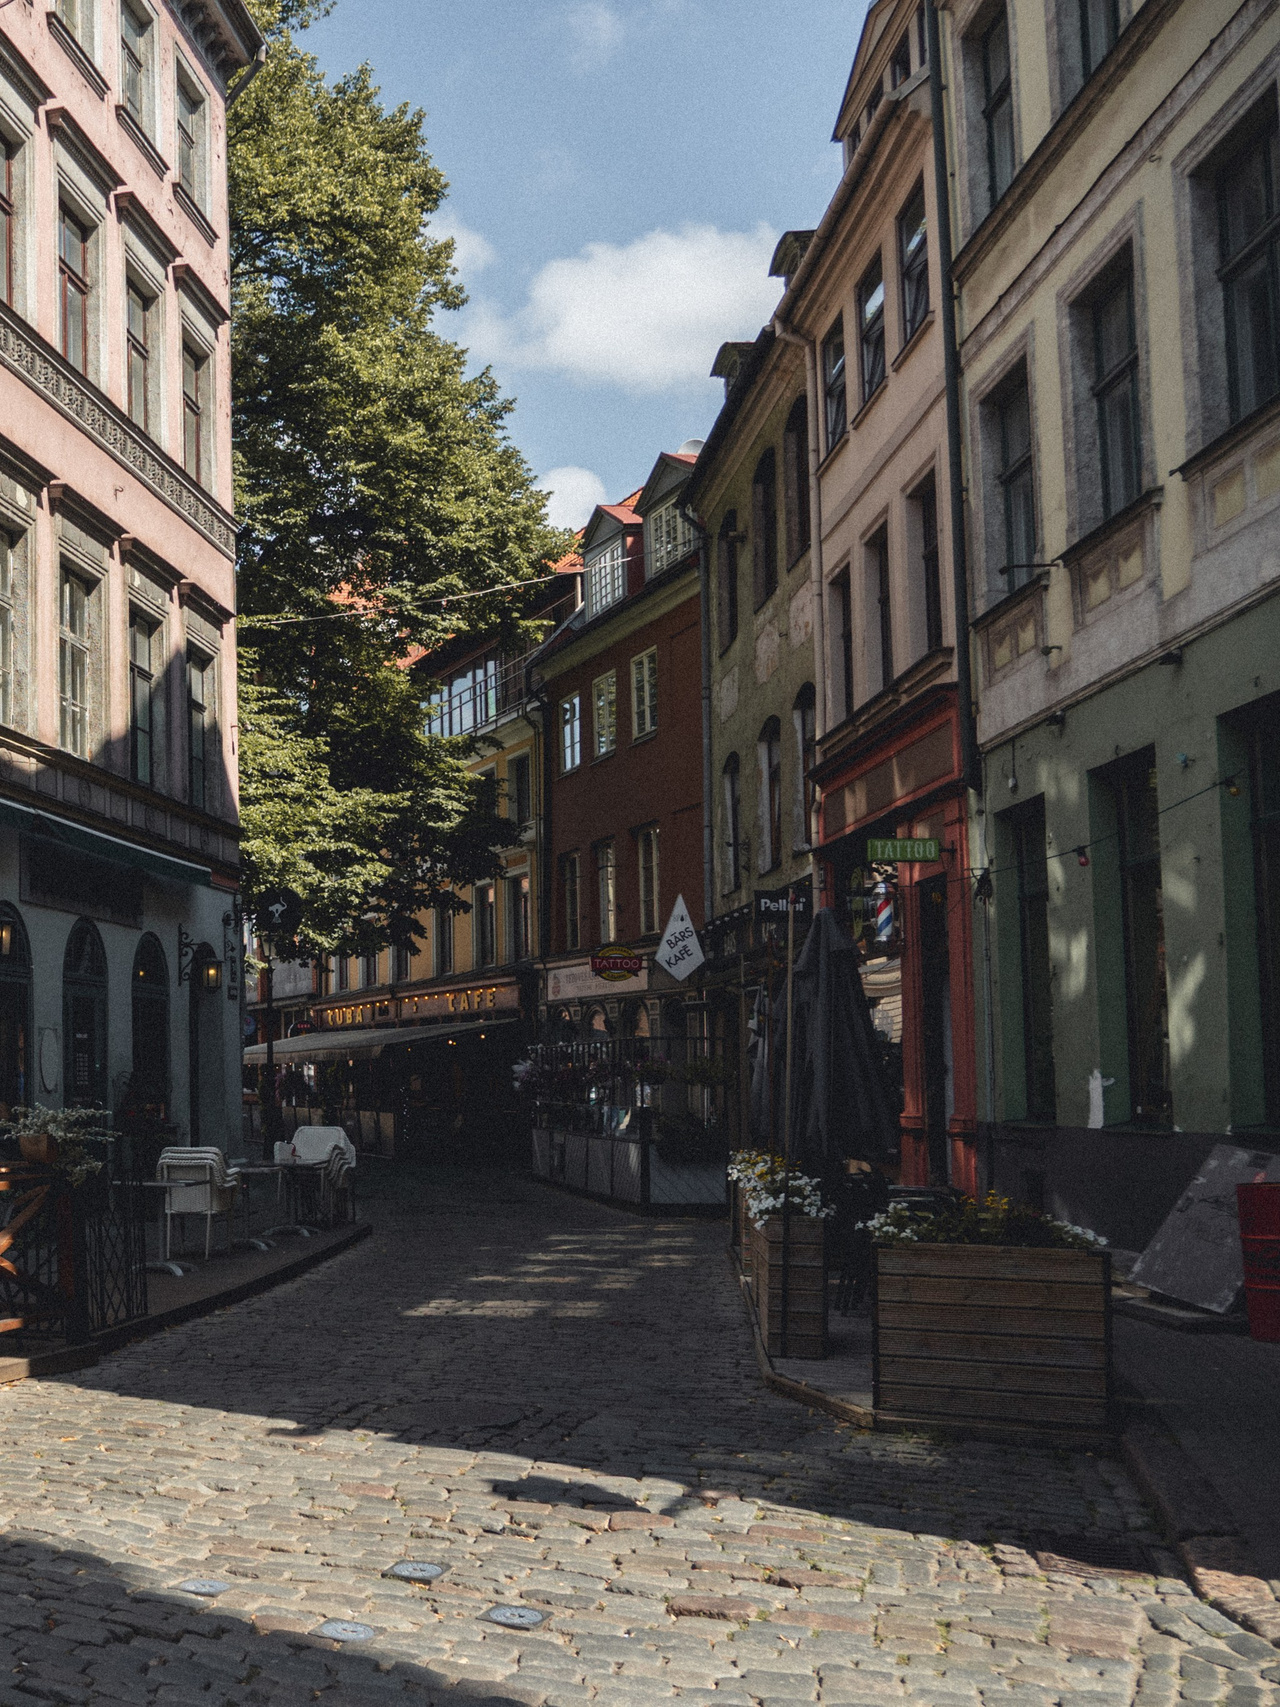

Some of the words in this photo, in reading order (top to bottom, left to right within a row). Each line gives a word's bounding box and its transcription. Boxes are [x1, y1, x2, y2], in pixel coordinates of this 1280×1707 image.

[875, 841, 936, 858] TATTOO
[666, 926, 694, 949] BĀRS
[593, 958, 640, 969] TATTOO
[328, 1007, 363, 1026] CUBA
[449, 989, 495, 1012] CAFE
